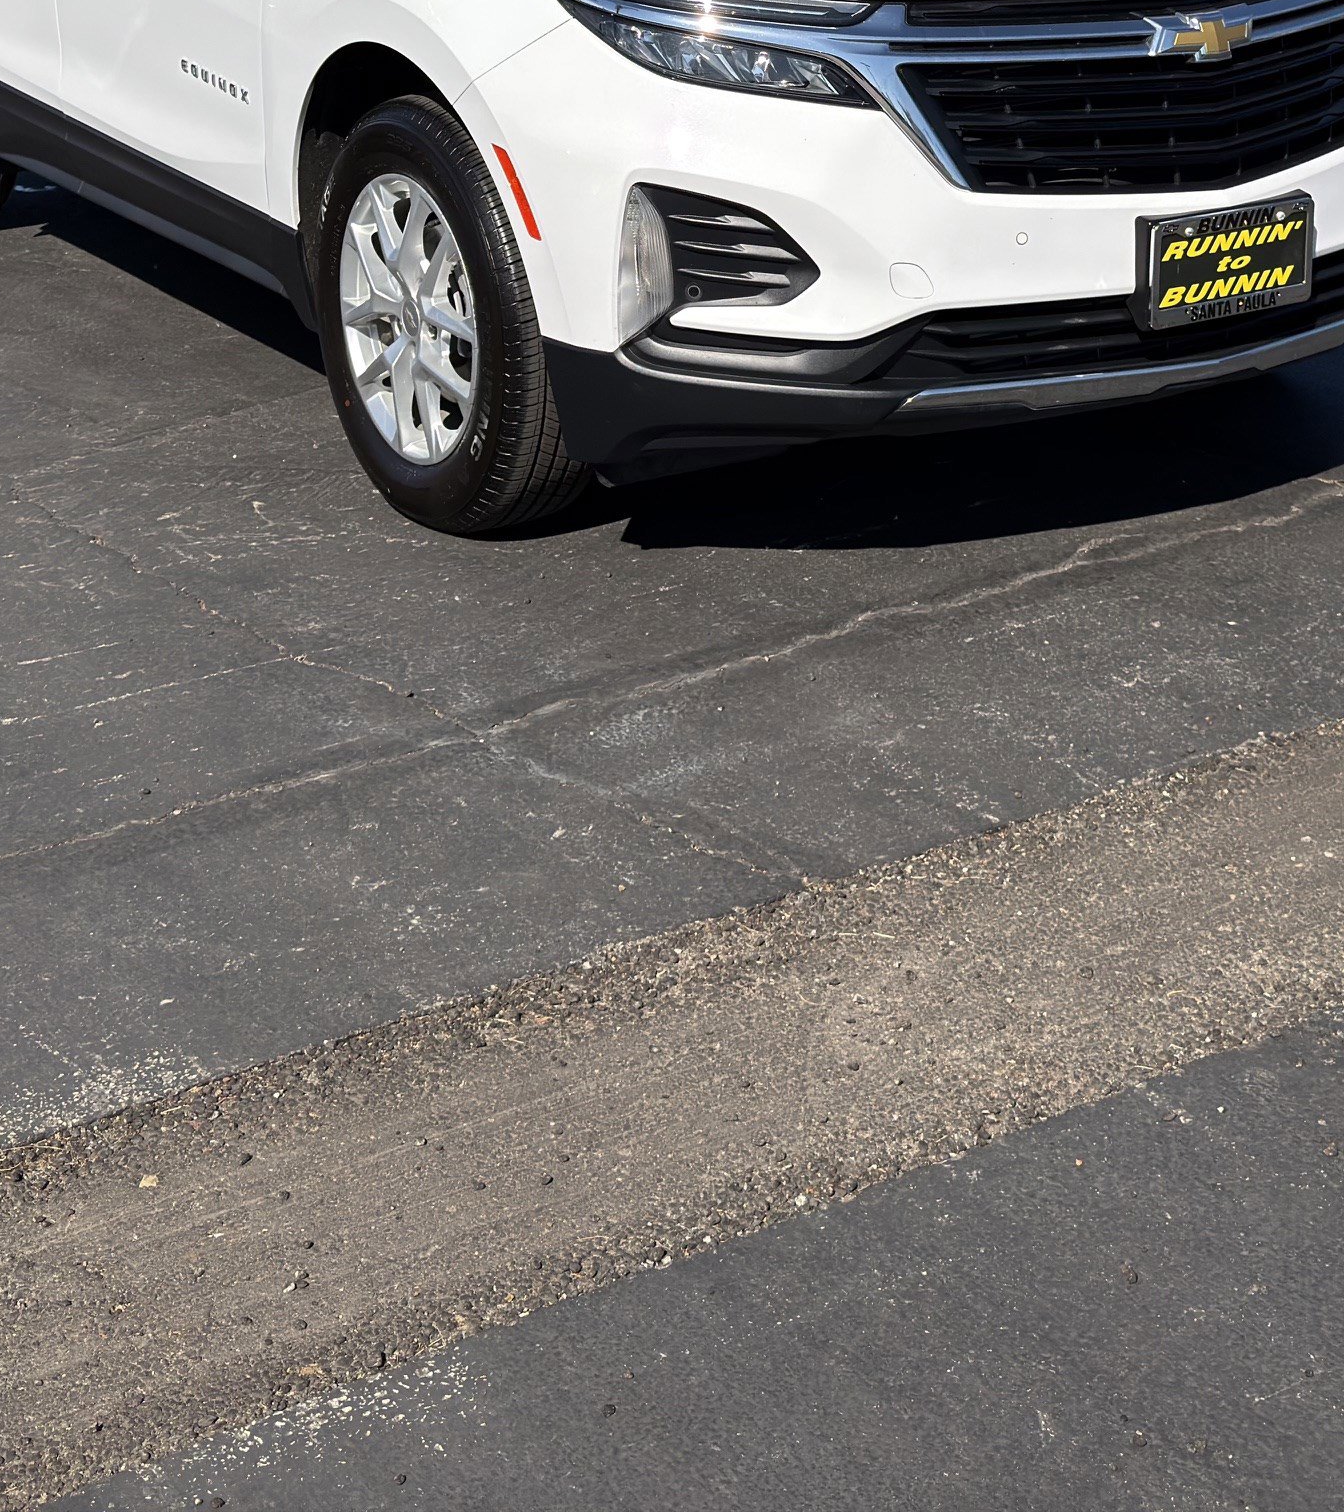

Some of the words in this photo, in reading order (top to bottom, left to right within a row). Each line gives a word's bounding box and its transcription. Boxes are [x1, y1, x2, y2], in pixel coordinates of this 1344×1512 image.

[181, 58, 250, 105] EQUINOX
[1197, 207, 1277, 234] BUNNIN
[1161, 220, 1304, 262] RUNNIN'
[1216, 254, 1252, 273] to
[1158, 264, 1295, 309] BUNNIN
[1189, 300, 1232, 322] SANTA
[1236, 291, 1277, 314] PAULA
